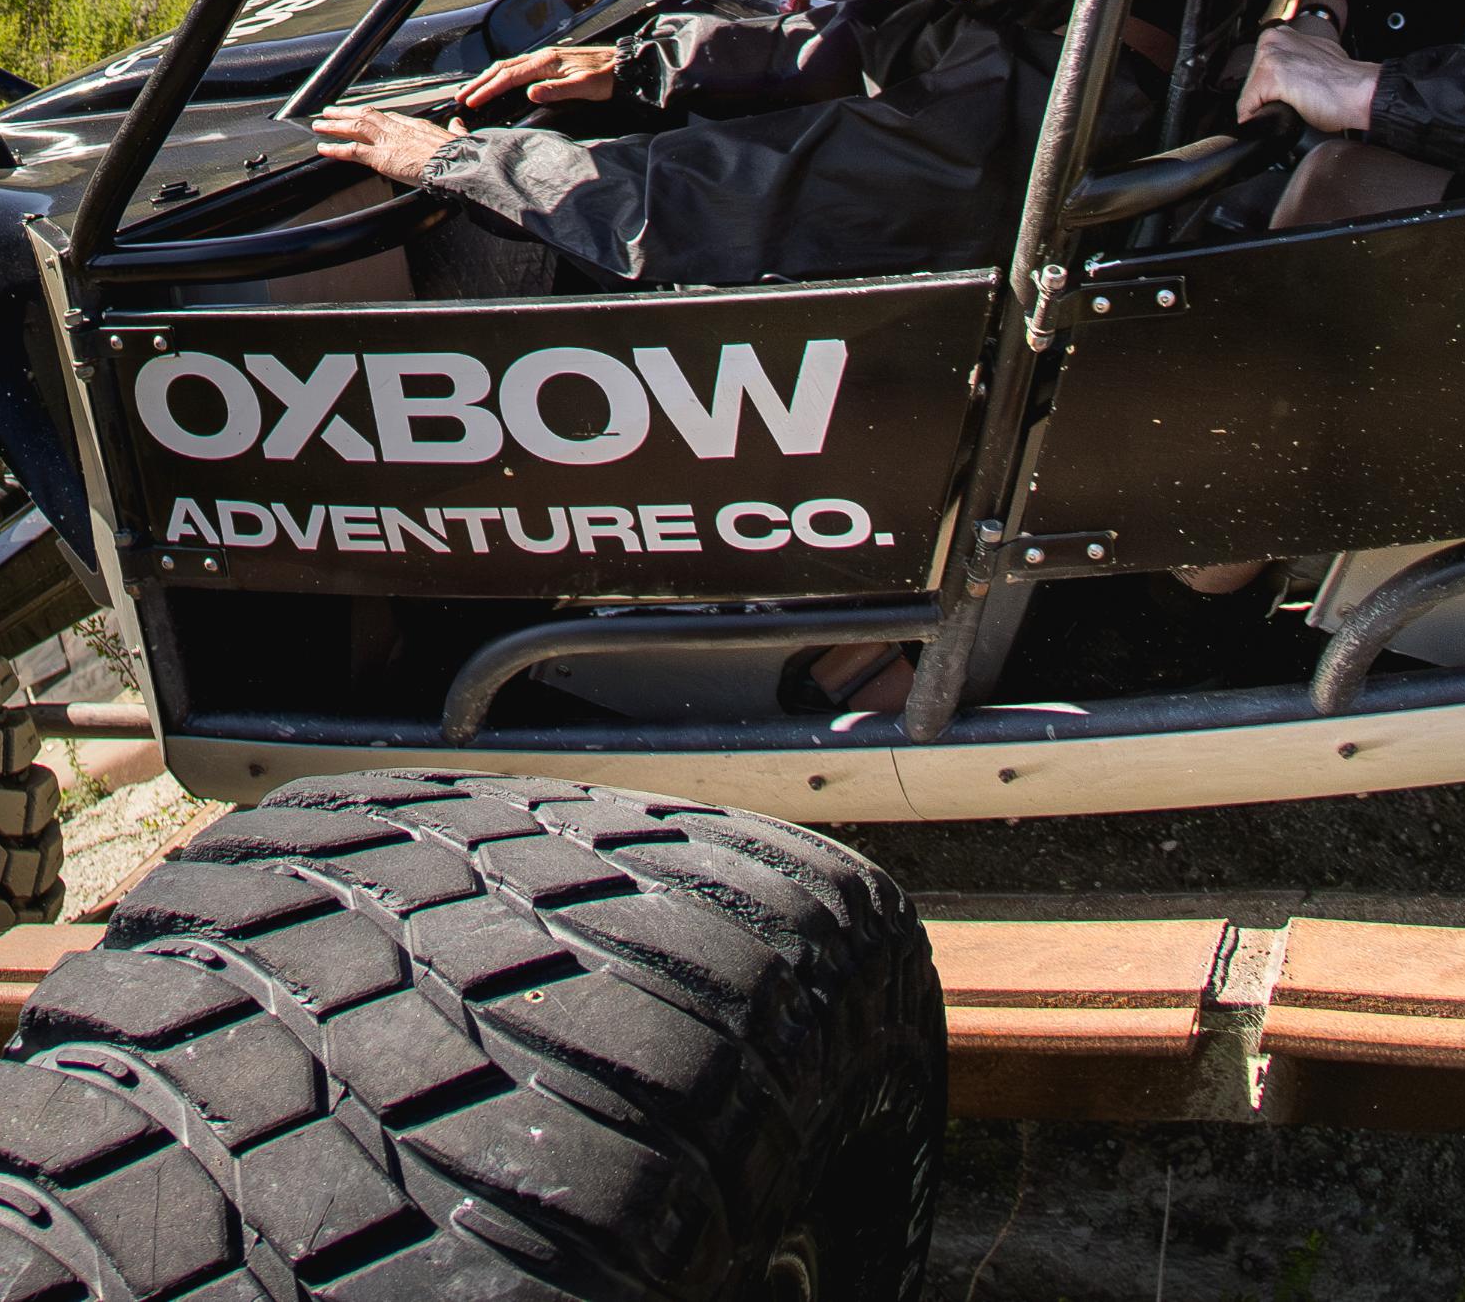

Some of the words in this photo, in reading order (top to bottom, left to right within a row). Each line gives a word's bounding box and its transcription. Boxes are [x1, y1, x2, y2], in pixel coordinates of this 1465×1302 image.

[134, 339, 849, 465] OXBOW
[165, 497, 703, 554] ADVENTURE
[715, 498, 895, 551] CO.
